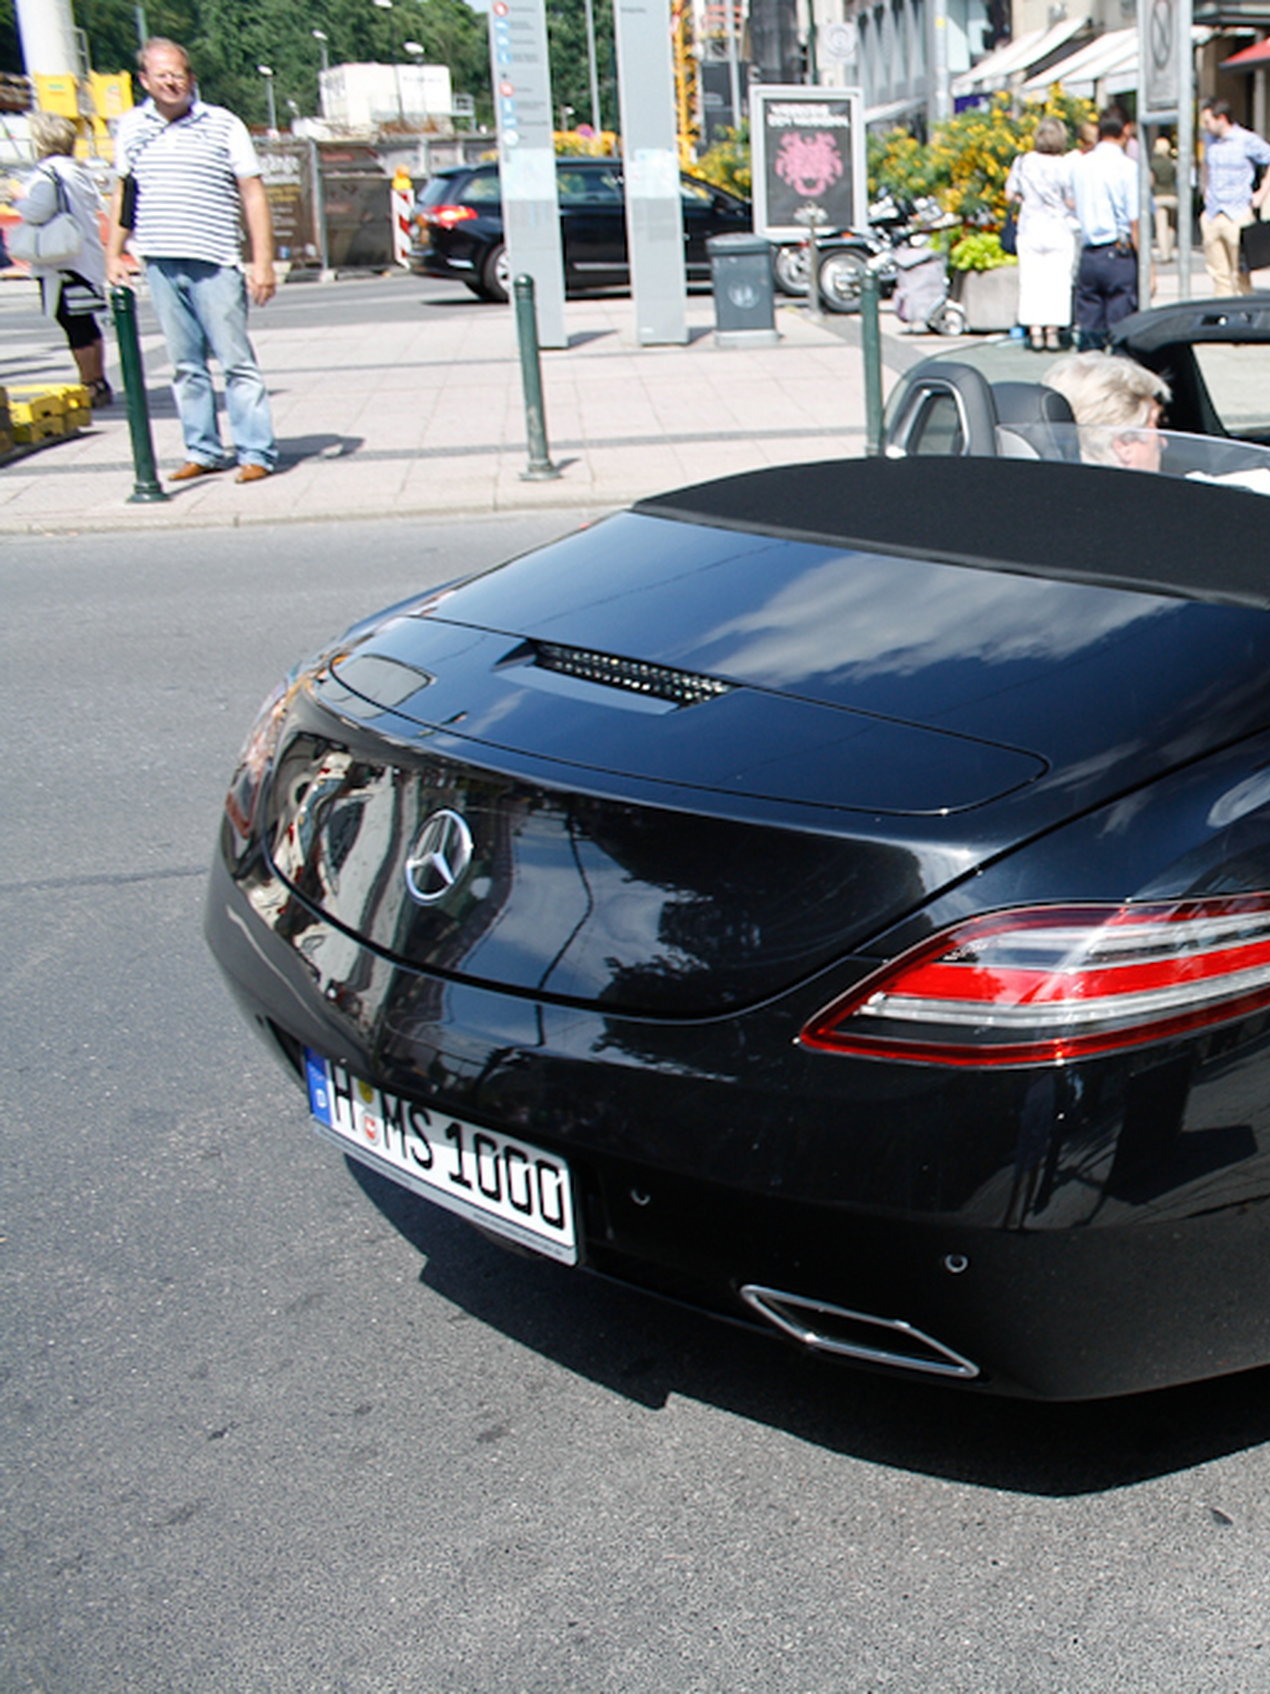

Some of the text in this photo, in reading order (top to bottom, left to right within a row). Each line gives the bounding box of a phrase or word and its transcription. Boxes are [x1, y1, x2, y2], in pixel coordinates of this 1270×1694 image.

[331, 1063, 356, 1131] H
[380, 1087, 434, 1170] MS
[445, 1121, 565, 1231] 1000
